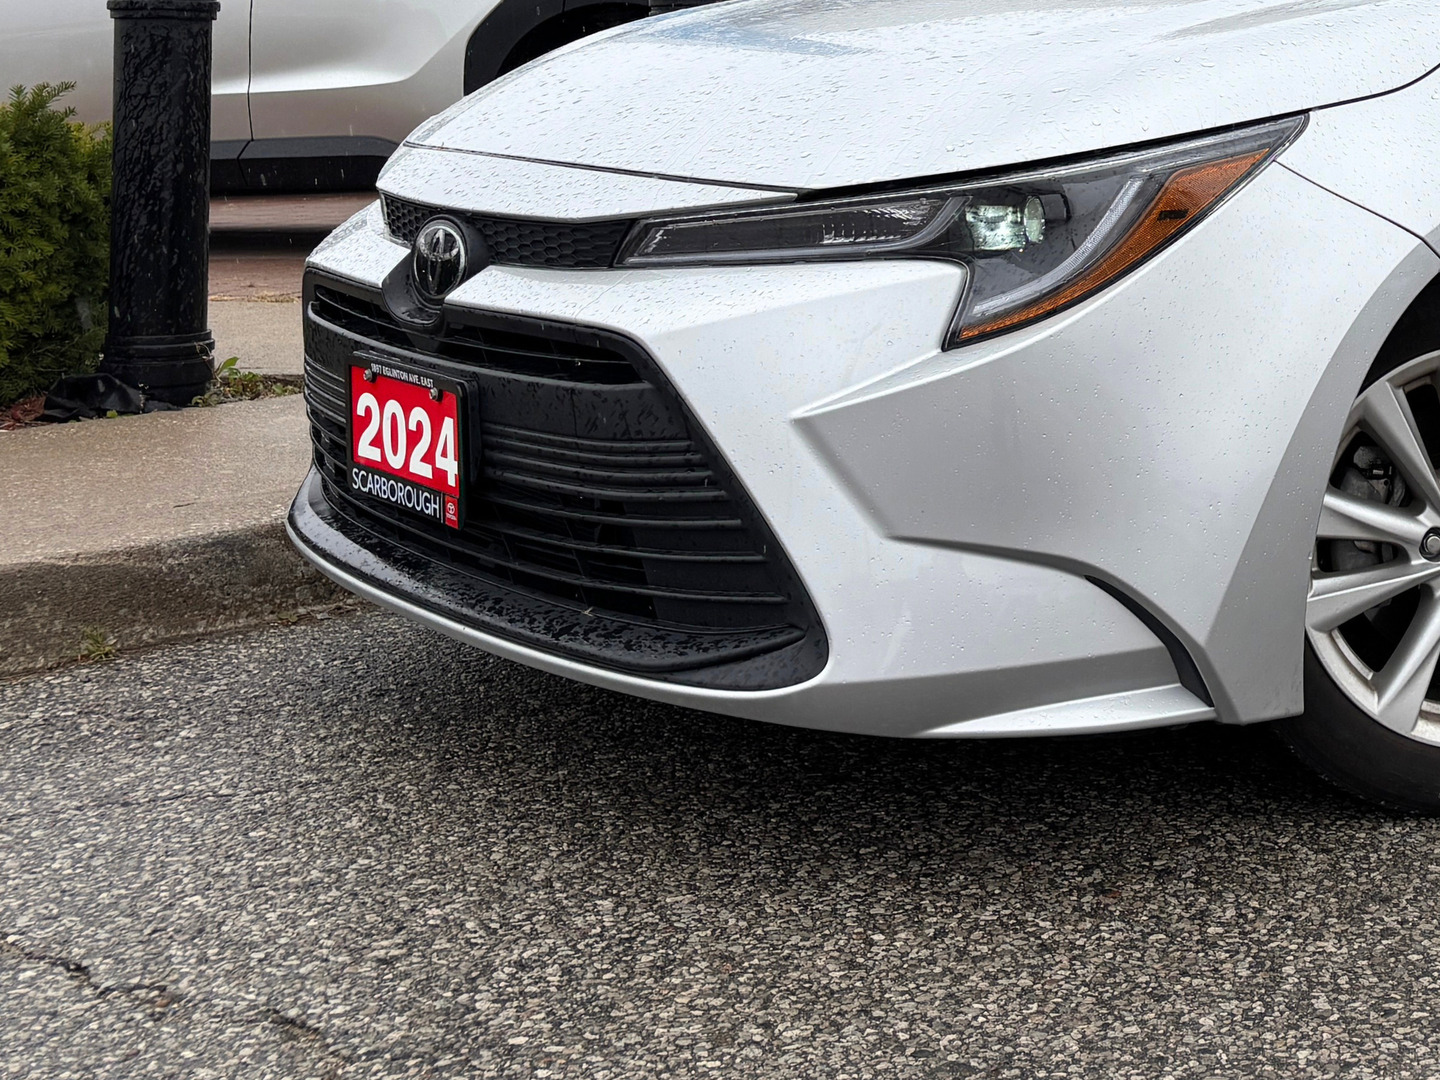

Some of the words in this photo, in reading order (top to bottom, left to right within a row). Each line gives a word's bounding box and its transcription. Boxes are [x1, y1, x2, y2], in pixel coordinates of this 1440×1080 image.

[382, 366, 408, 382] EGLINTON
[420, 376, 434, 388] EAST
[356, 392, 458, 487] 2024
[352, 468, 439, 518] SCARBOROUGH
